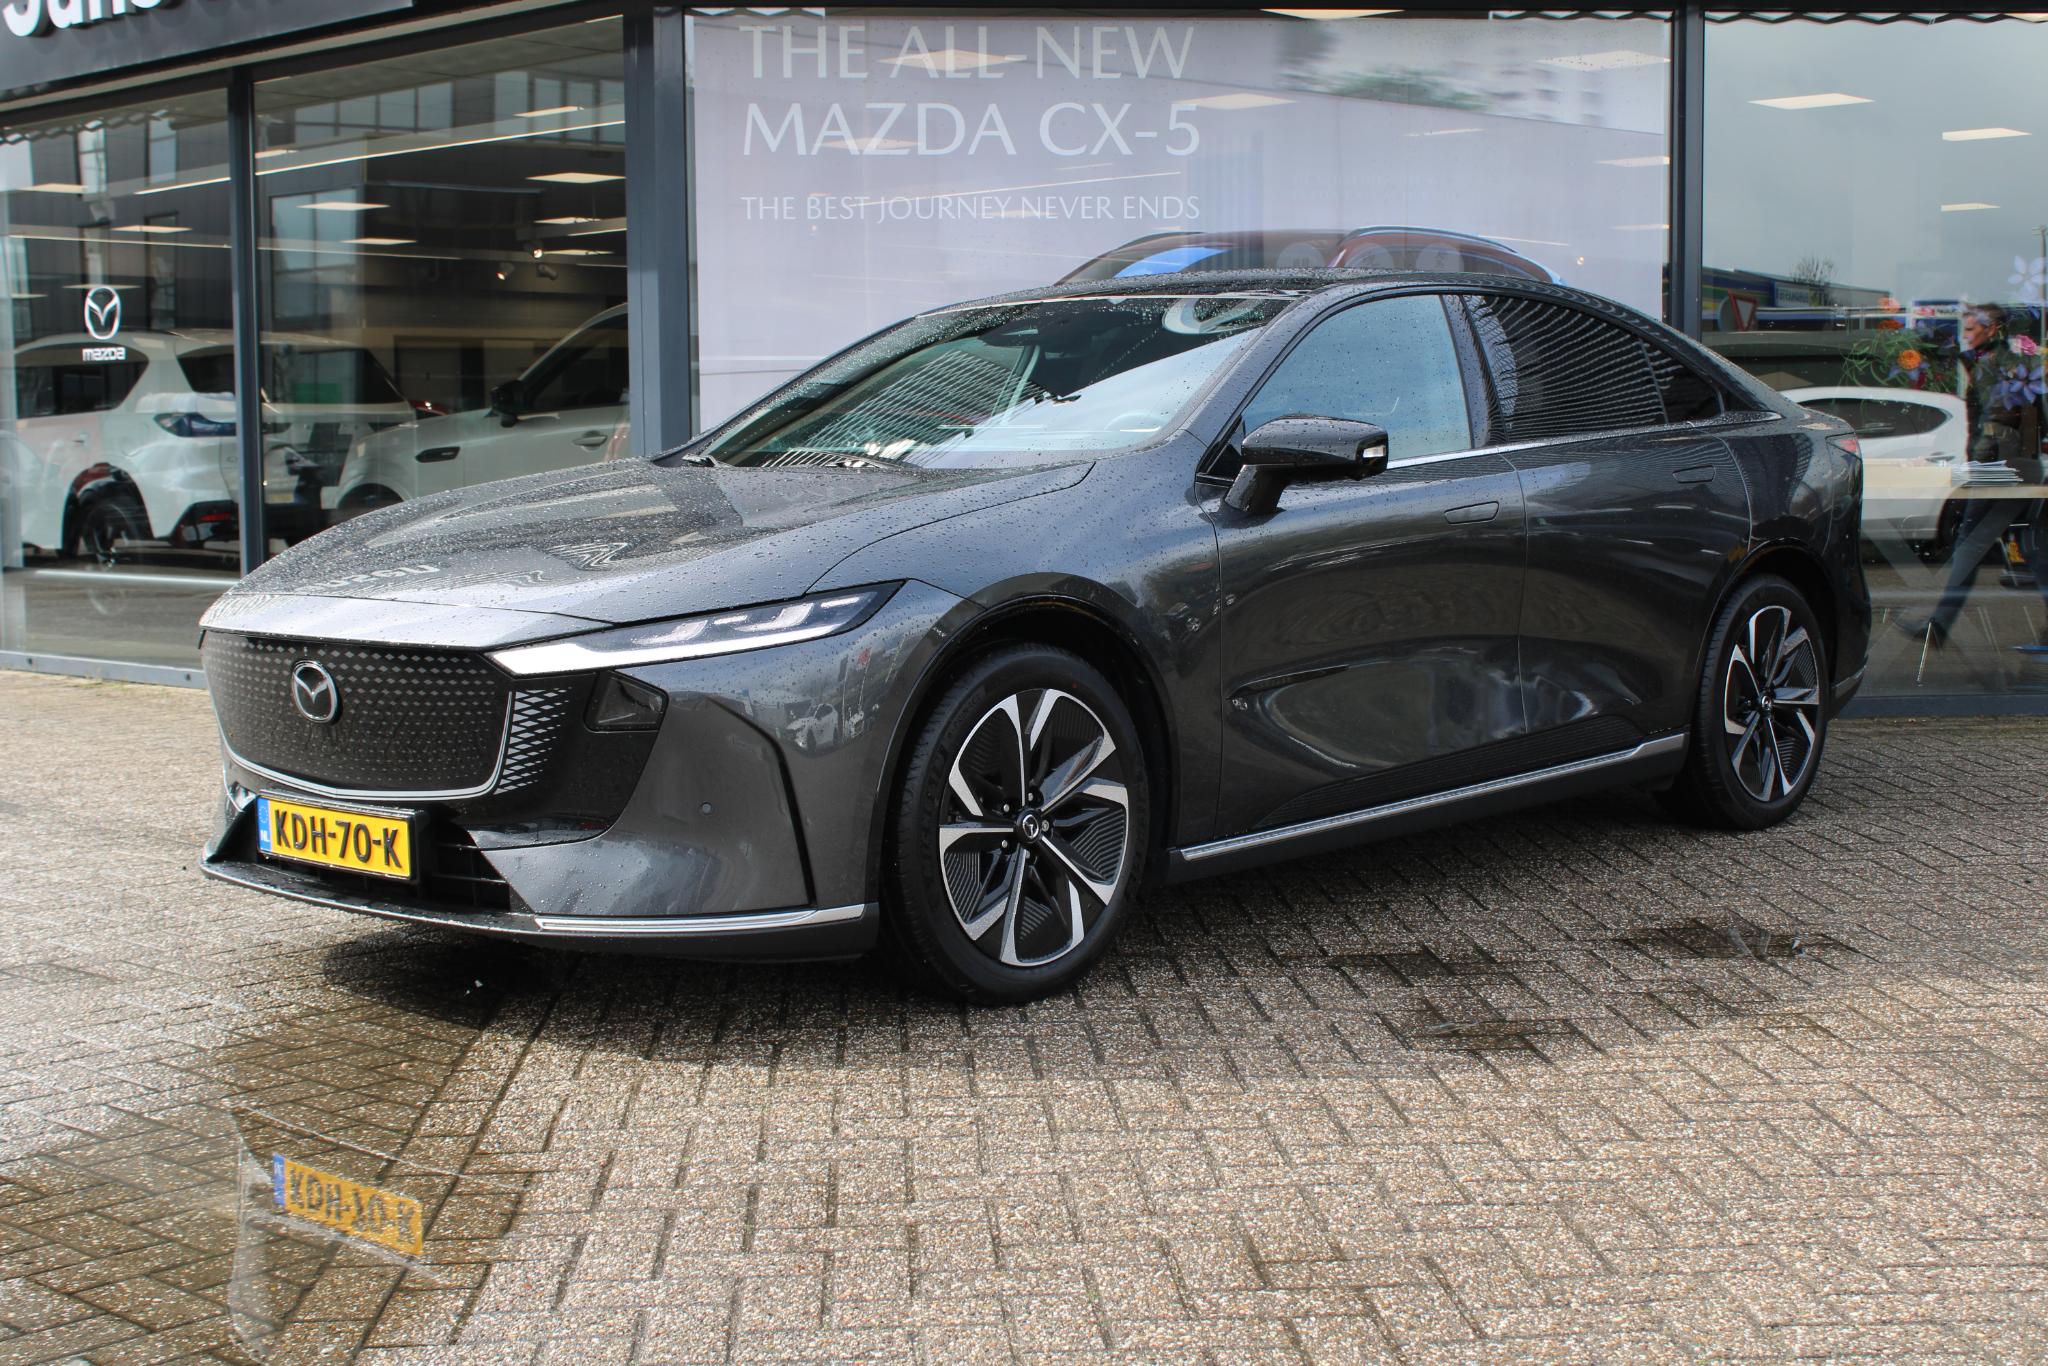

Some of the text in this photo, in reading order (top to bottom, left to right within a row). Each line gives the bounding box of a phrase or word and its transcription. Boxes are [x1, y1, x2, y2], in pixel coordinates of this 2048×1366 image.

[739, 25, 1194, 79] THE ALL-NEW
[744, 102, 1200, 156] MAZDA CX-5
[741, 196, 1200, 223] THE BEST JOURNEY NEVER ENDS
[82, 347, 126, 361] mazda
[274, 808, 402, 868] KDH-70-K
